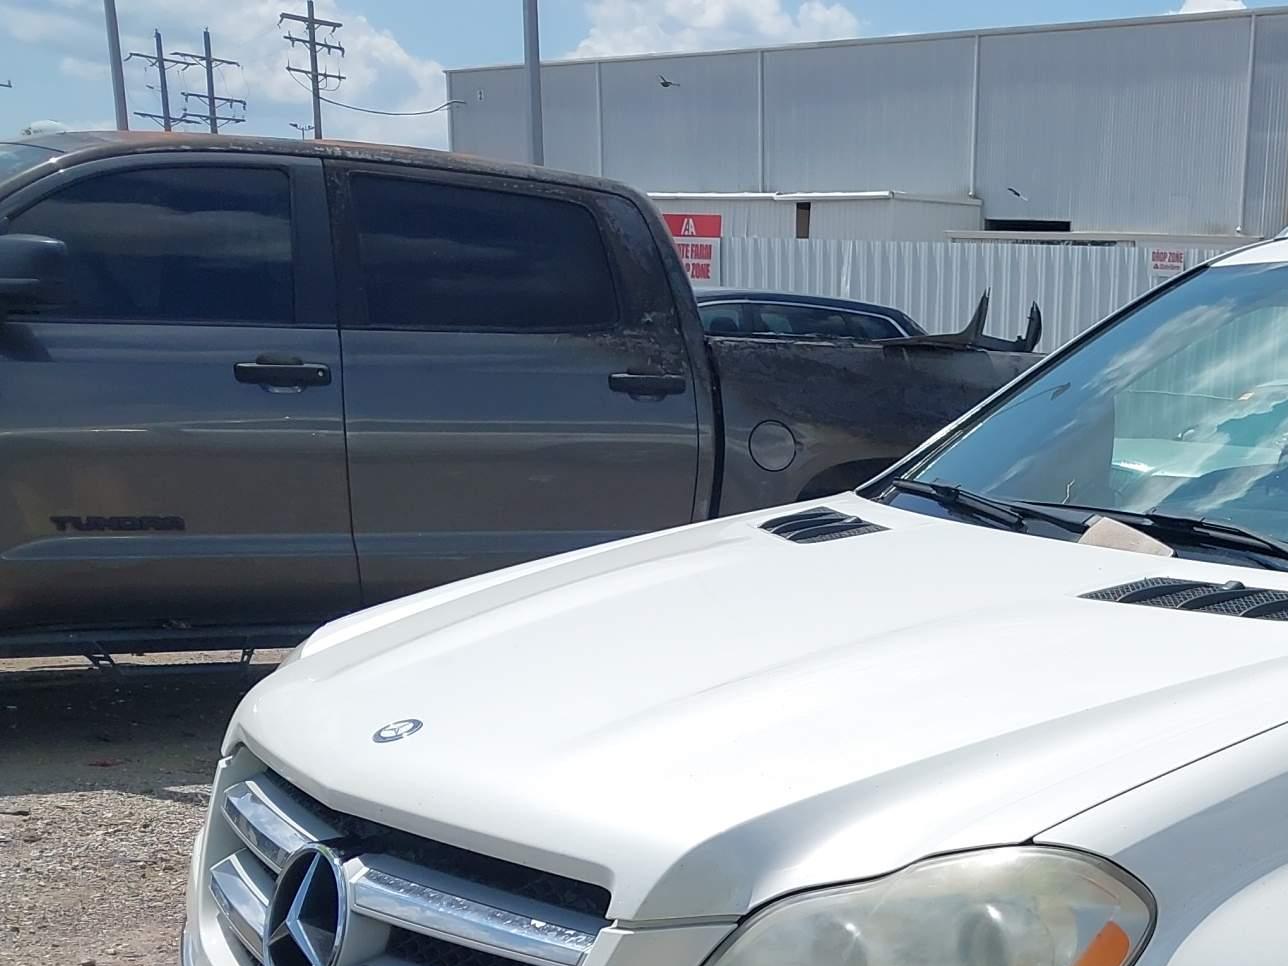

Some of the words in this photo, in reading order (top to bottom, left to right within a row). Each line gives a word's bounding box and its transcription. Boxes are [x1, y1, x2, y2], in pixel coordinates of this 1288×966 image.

[1167, 251, 1184, 263] ZONE
[690, 263, 711, 280] ZONE
[49, 515, 186, 531] TUNDRA
